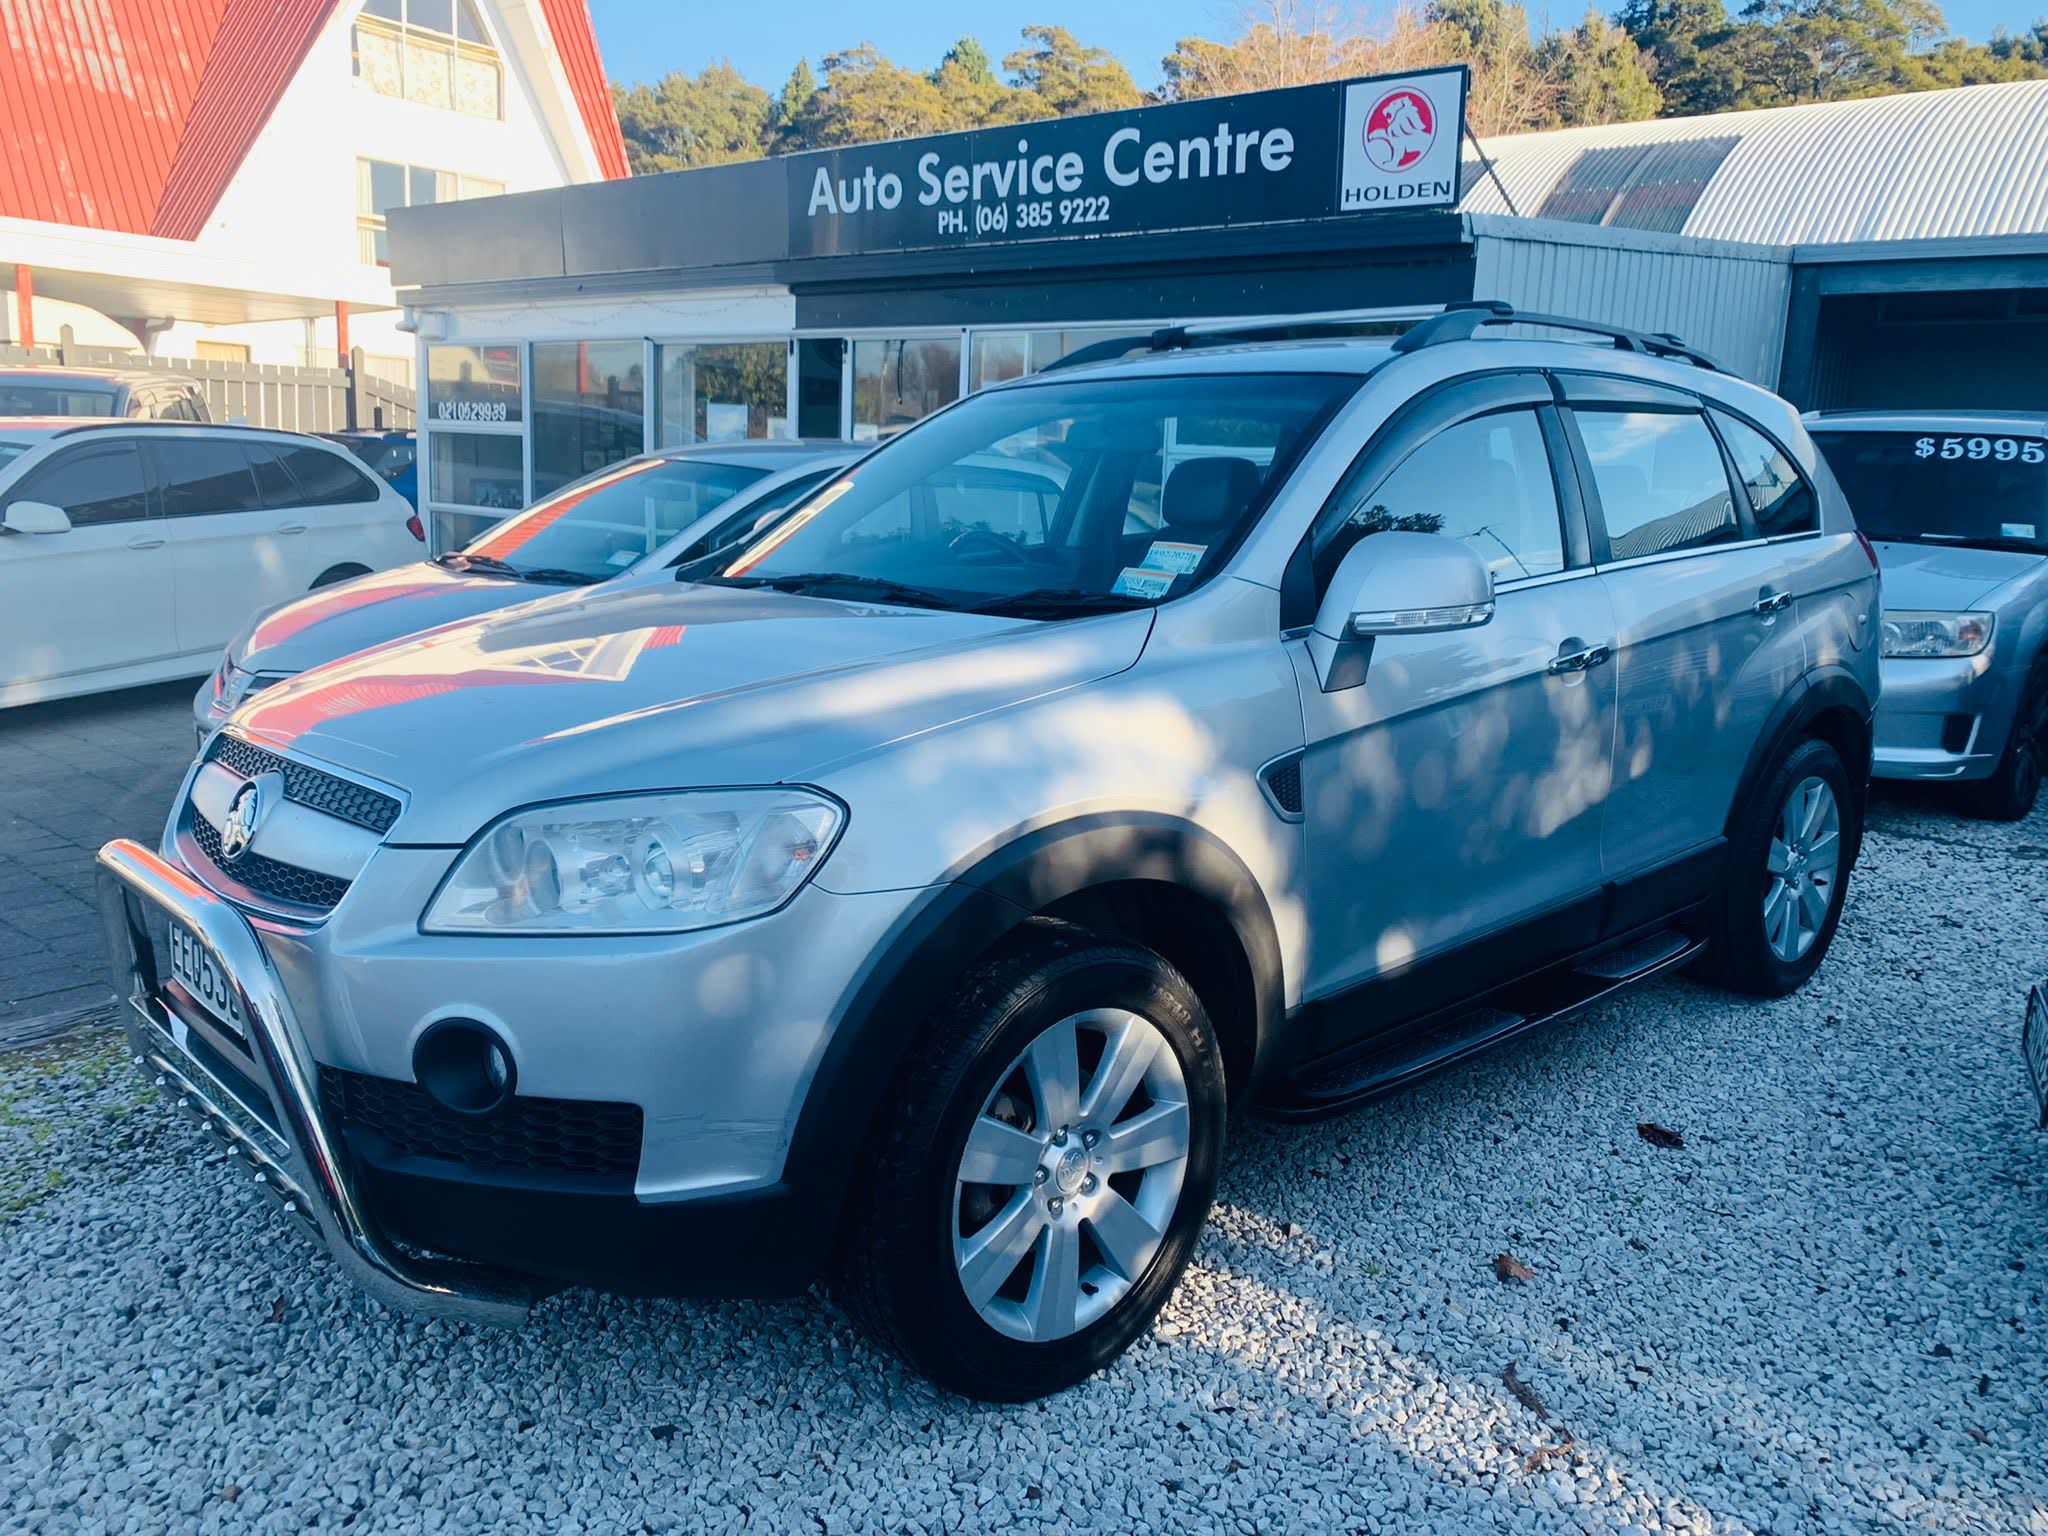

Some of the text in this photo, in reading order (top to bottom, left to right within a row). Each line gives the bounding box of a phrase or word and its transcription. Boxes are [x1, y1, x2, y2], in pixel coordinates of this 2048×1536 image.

[808, 123, 1295, 217] Auto Service Centre
[1344, 181, 1451, 203] HOLDEN
[938, 196, 1110, 234] PH. (06) 385 9222
[1914, 437, 2046, 464] $5995
